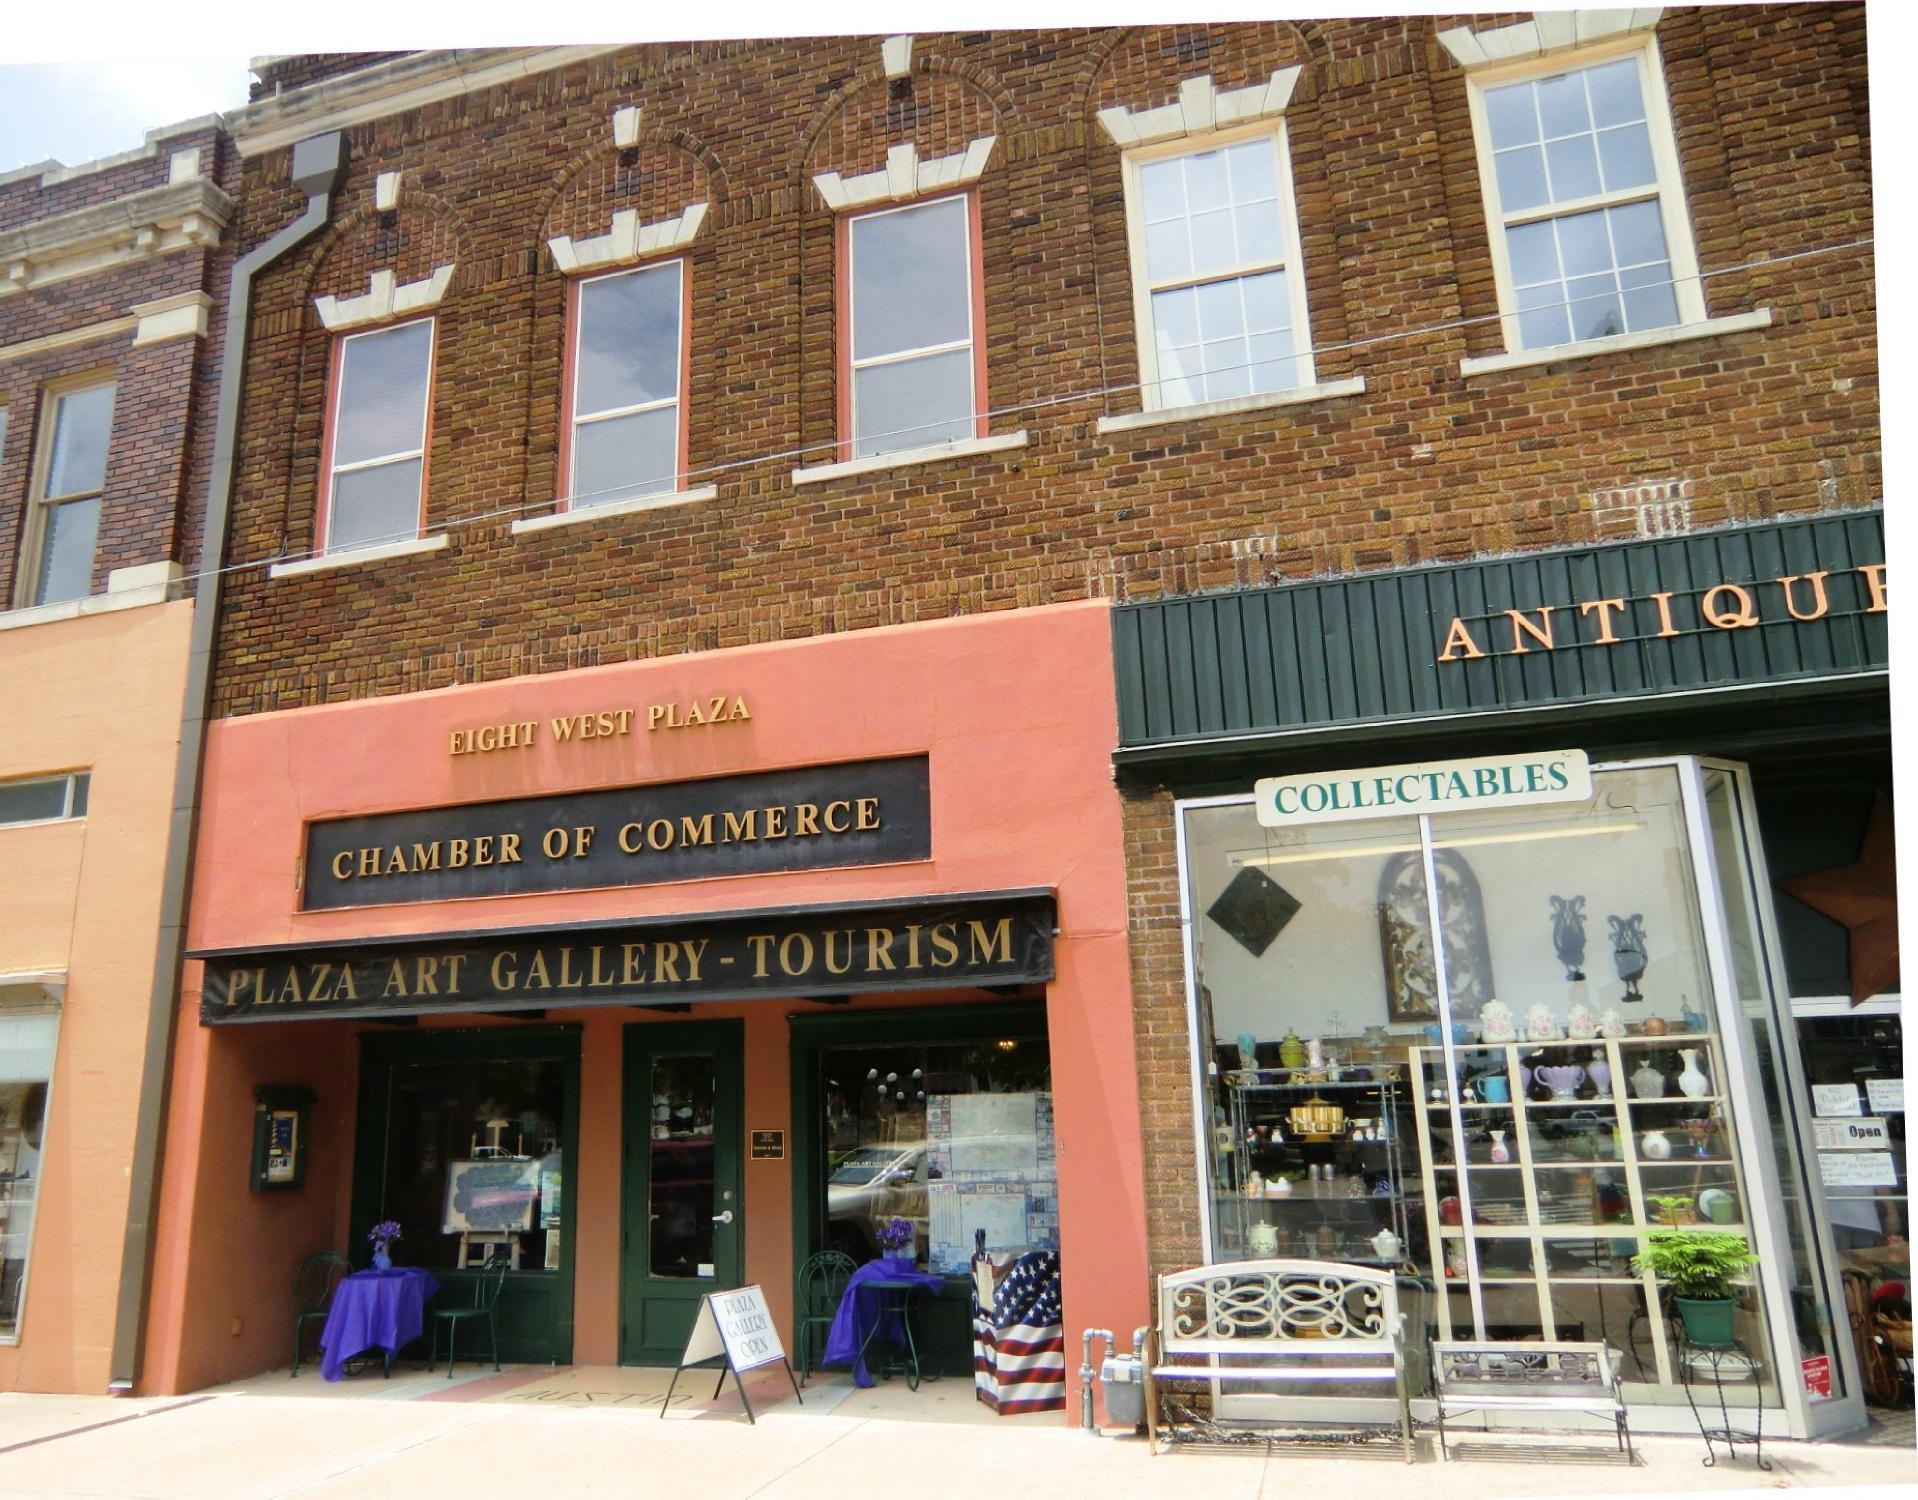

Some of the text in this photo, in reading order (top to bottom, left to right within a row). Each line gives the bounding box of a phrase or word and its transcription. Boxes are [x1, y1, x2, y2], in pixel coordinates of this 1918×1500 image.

[449, 695, 752, 755] EIGHT WEST PLAZA
[1273, 761, 1569, 815] COLLECTABLES
[332, 796, 882, 880] CHAMBER OF COMMERCE
[225, 961, 358, 1007] PLAZA
[382, 953, 468, 999] ART
[490, 938, 710, 991] GALLERY
[747, 917, 1016, 978] TOURISM
[1848, 1125, 1882, 1139] Open
[724, 1295, 756, 1315] PLAZA
[726, 1313, 768, 1338] GALLERY
[740, 1336, 769, 1358] OPEN
